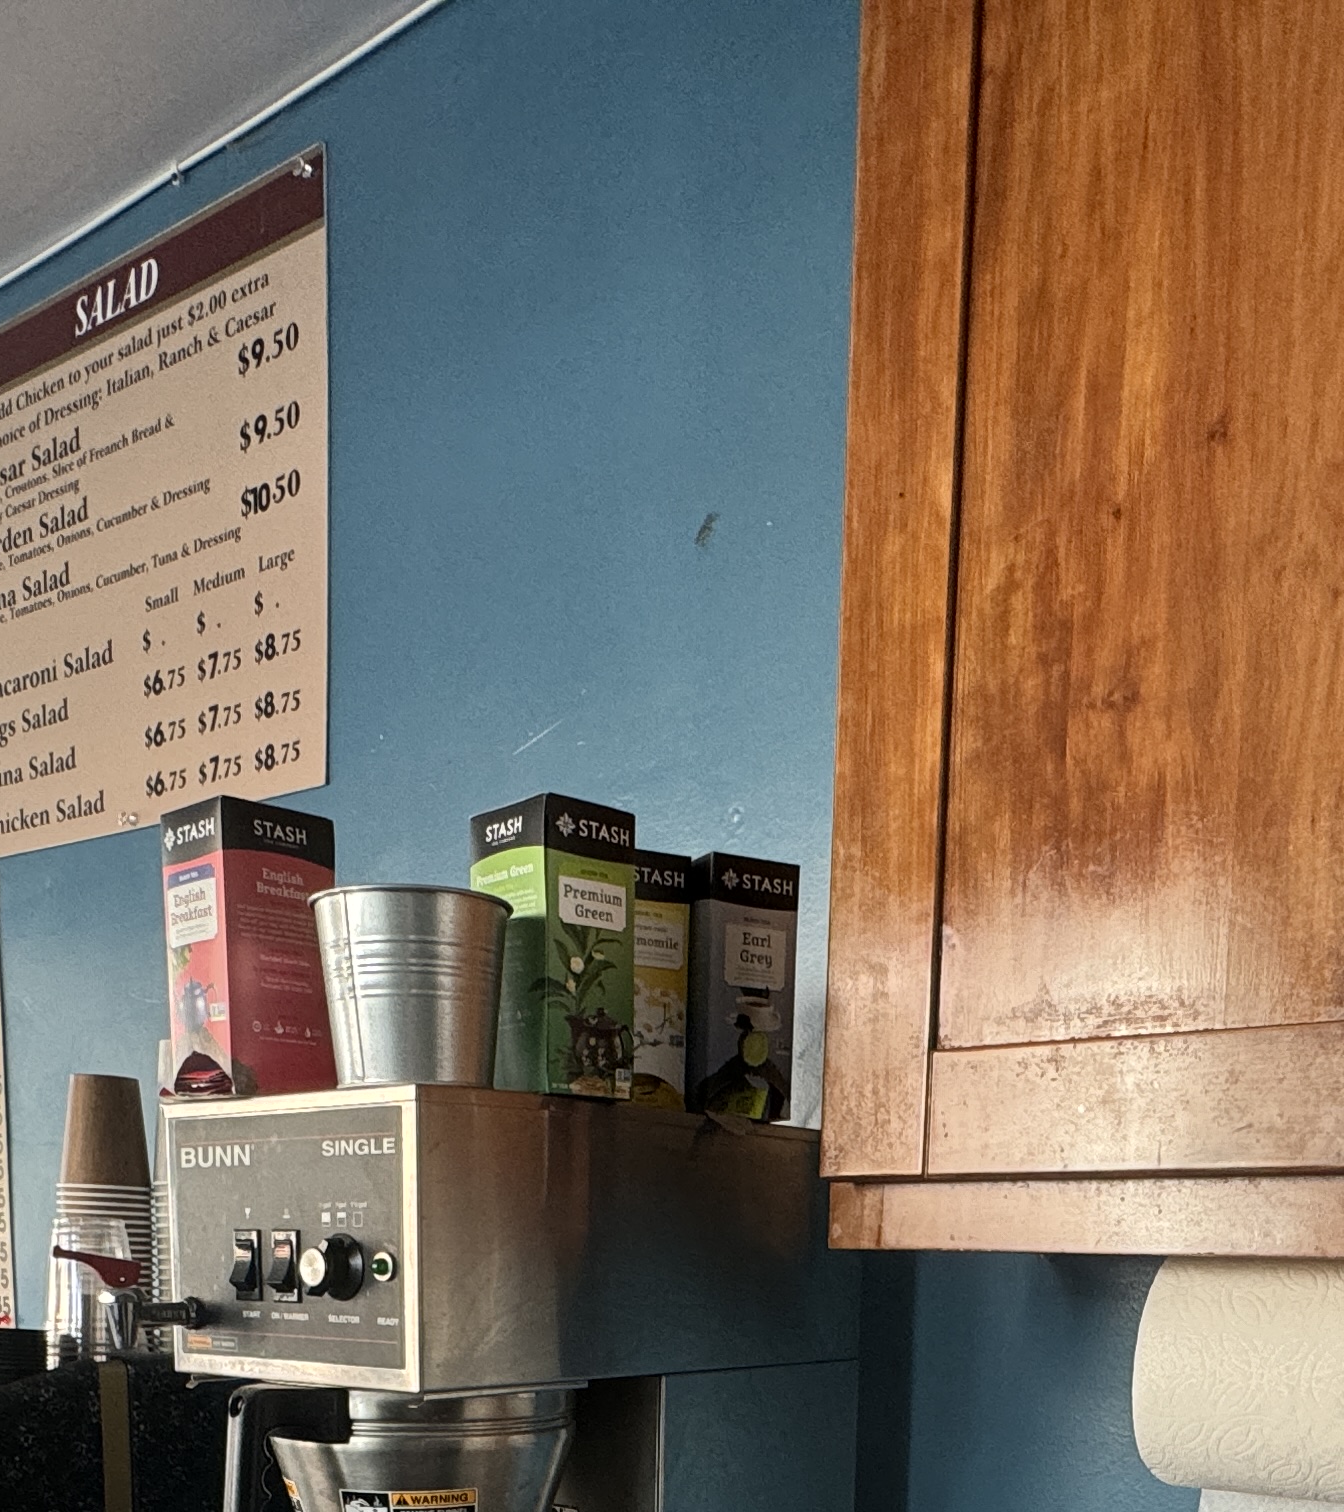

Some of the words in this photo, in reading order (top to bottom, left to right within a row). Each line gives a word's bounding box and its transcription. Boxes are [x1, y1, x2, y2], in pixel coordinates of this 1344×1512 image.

[75, 259, 157, 335] SALAD
[15, 378, 64, 410] Chicken
[68, 369, 81, 385] to
[84, 352, 113, 384] your
[117, 327, 152, 360] salad
[156, 316, 183, 348] just
[187, 290, 226, 325] $2.00
[231, 273, 268, 302] extra
[27, 411, 40, 433] of
[44, 388, 101, 425] Dressing:
[106, 365, 153, 395] Italian,
[158, 335, 202, 370] Ranch
[207, 326, 220, 347] &
[224, 302, 276, 337] Caesar
[31, 426, 80, 470] Salad
[238, 322, 298, 375] $9.50
[51, 461, 74, 478] Slice
[76, 450, 86, 468] of
[88, 433, 128, 462] Freanch
[131, 417, 161, 443] Bread
[164, 413, 174, 428] &
[39, 496, 88, 537] Salad
[239, 401, 299, 451] $9.50
[4, 498, 35, 517] Caesar
[37, 479, 79, 504] Dressing
[56, 527, 93, 547] Onions,
[95, 504, 147, 531] Cucumber
[150, 495, 160, 511] &
[162, 478, 210, 505] Dressing
[22, 561, 69, 600] Salad
[241, 469, 300, 516] $10.50
[95, 562, 148, 588] Cucumber,
[150, 550, 178, 568] Tuna
[180, 543, 190, 558] &
[193, 526, 241, 552] Dressing
[145, 586, 178, 612] Small
[193, 567, 245, 595] Medium
[258, 549, 294, 572] Large
[63, 639, 113, 677] Salad
[21, 697, 68, 732] Salad
[143, 666, 184, 697] $6.75
[197, 648, 241, 681] $7.75
[254, 629, 300, 663] $8.75
[29, 746, 75, 779] Salad
[145, 718, 185, 747] $6.75
[198, 703, 241, 734] $7.75
[254, 689, 300, 719] $8.75
[56, 789, 104, 822] Salad
[146, 769, 186, 796] $6.75
[198, 754, 241, 784] $7.75
[254, 740, 300, 771] $8.75
[176, 817, 215, 845] STASH
[253, 819, 307, 846] STASH
[485, 815, 523, 843] STASH
[579, 819, 630, 847] STASH
[262, 867, 304, 886] English
[476, 870, 509, 886] Premium
[509, 863, 534, 876] Green
[633, 866, 685, 888] STASH
[742, 873, 794, 896] STASH
[173, 887, 206, 909] English
[563, 884, 623, 907] Premium
[171, 905, 212, 926] Breakfast
[575, 904, 614, 923] Green
[742, 932, 772, 948] Earl
[739, 949, 773, 969] Grey
[180, 1144, 251, 1168] BUNN
[321, 1138, 396, 1157] SINGLE
[328, 1314, 360, 1324] SELECTOR
[411, 1493, 469, 1504] WARNING
